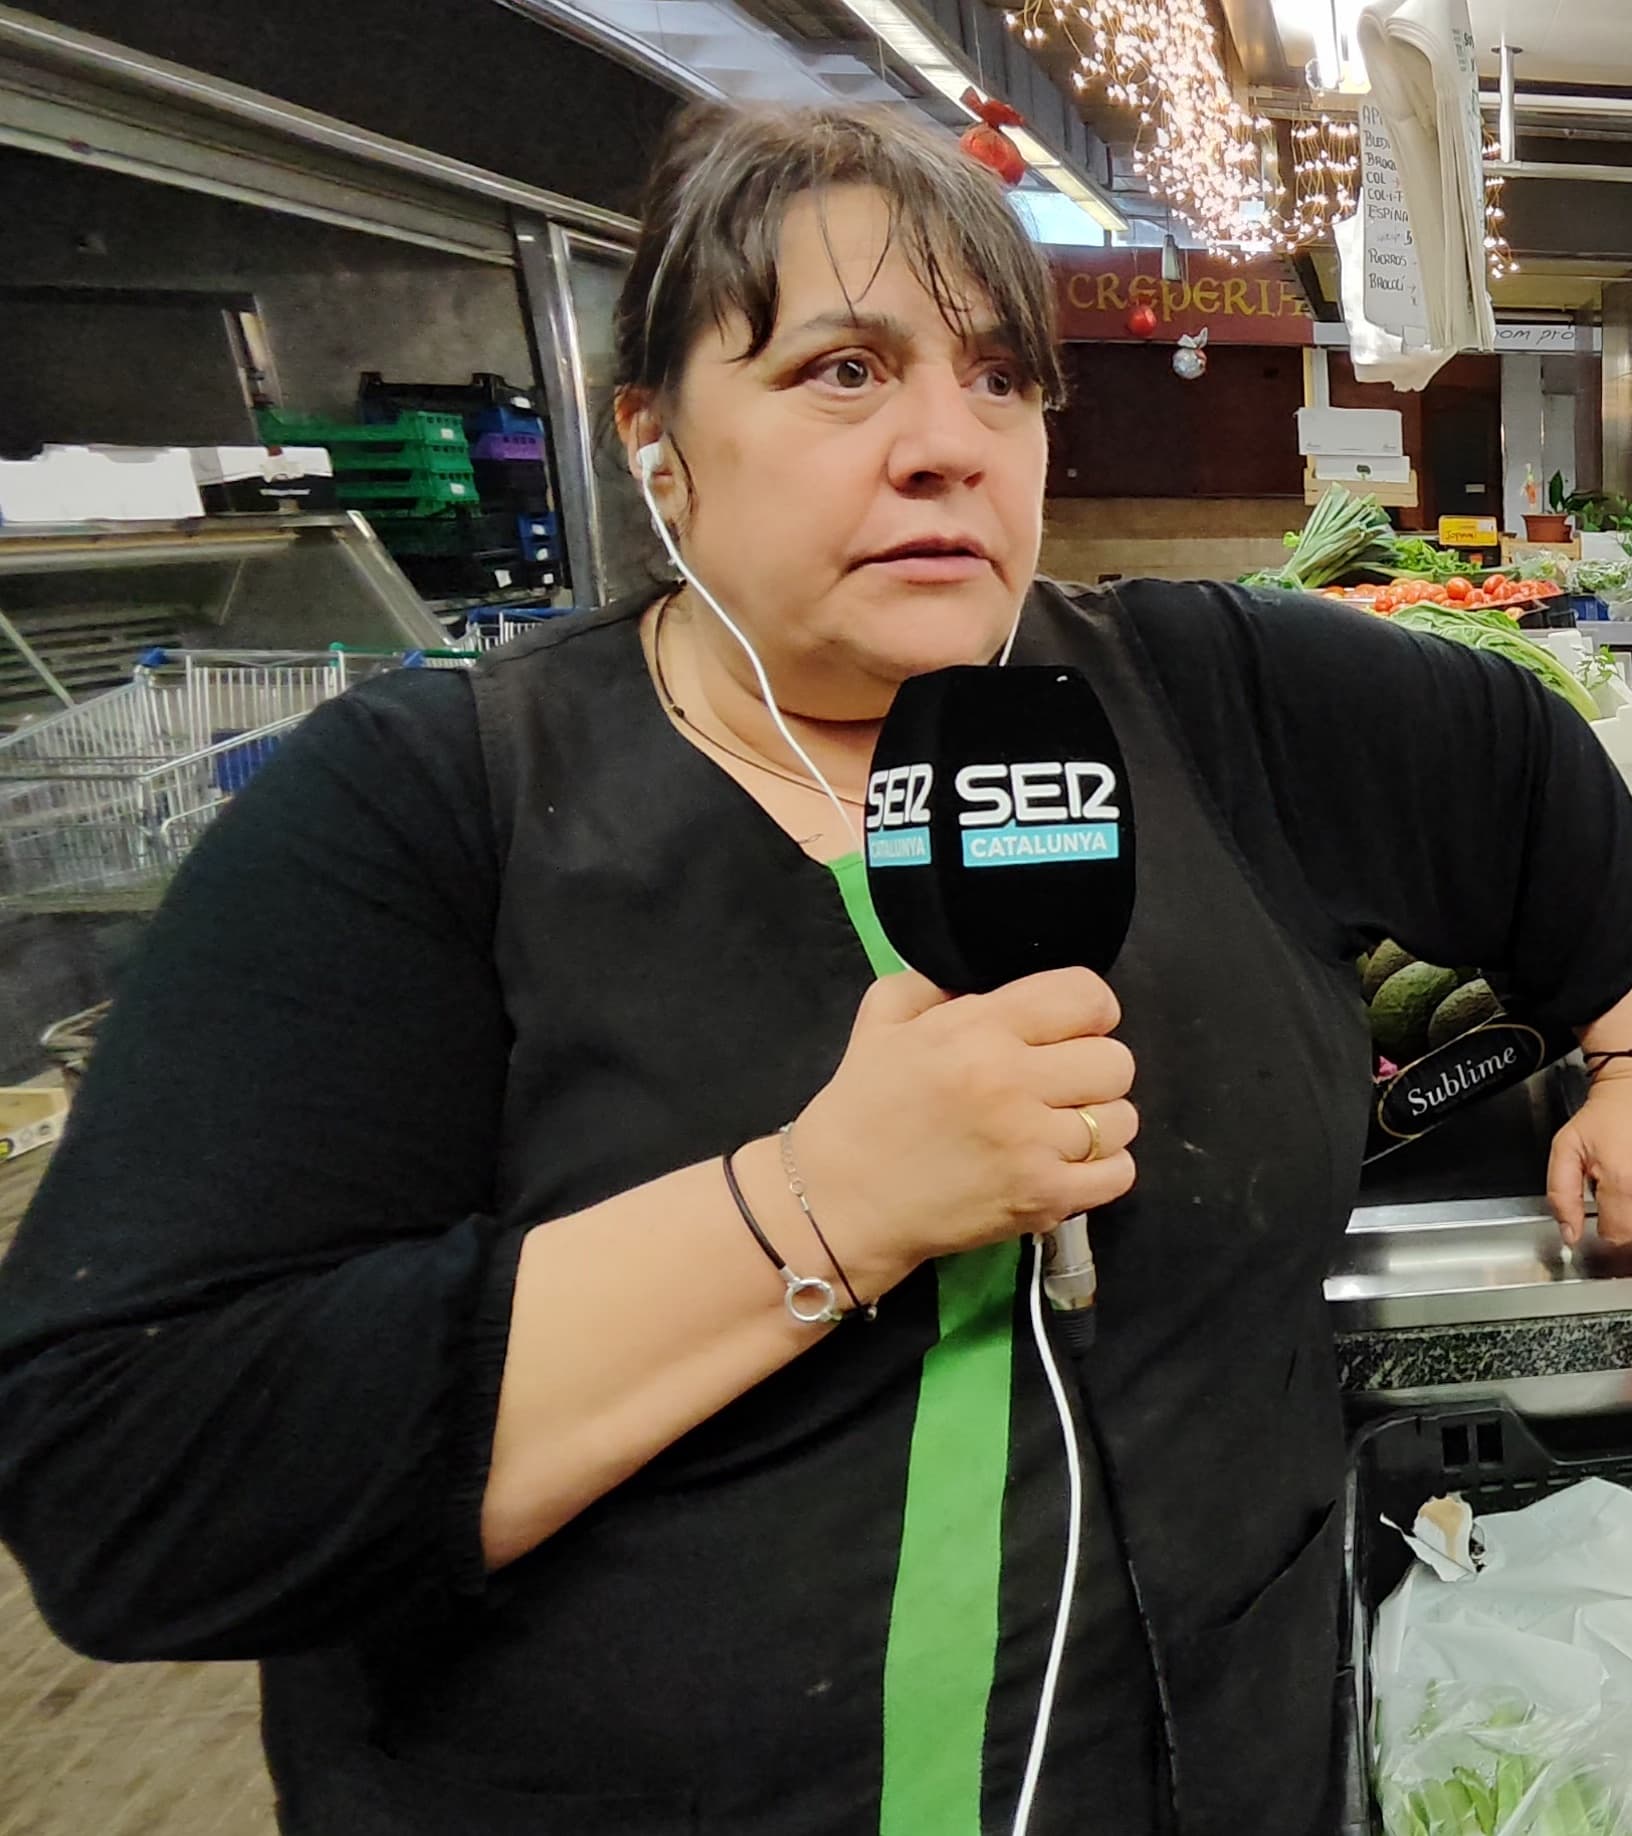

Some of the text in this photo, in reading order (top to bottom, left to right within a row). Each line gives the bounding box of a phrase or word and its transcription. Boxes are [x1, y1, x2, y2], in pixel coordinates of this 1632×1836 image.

[866, 762, 934, 829] SER
[955, 761, 1120, 826] SER
[970, 832, 1108, 858] CATALUNYA
[1407, 1044, 1519, 1117] Sublime
